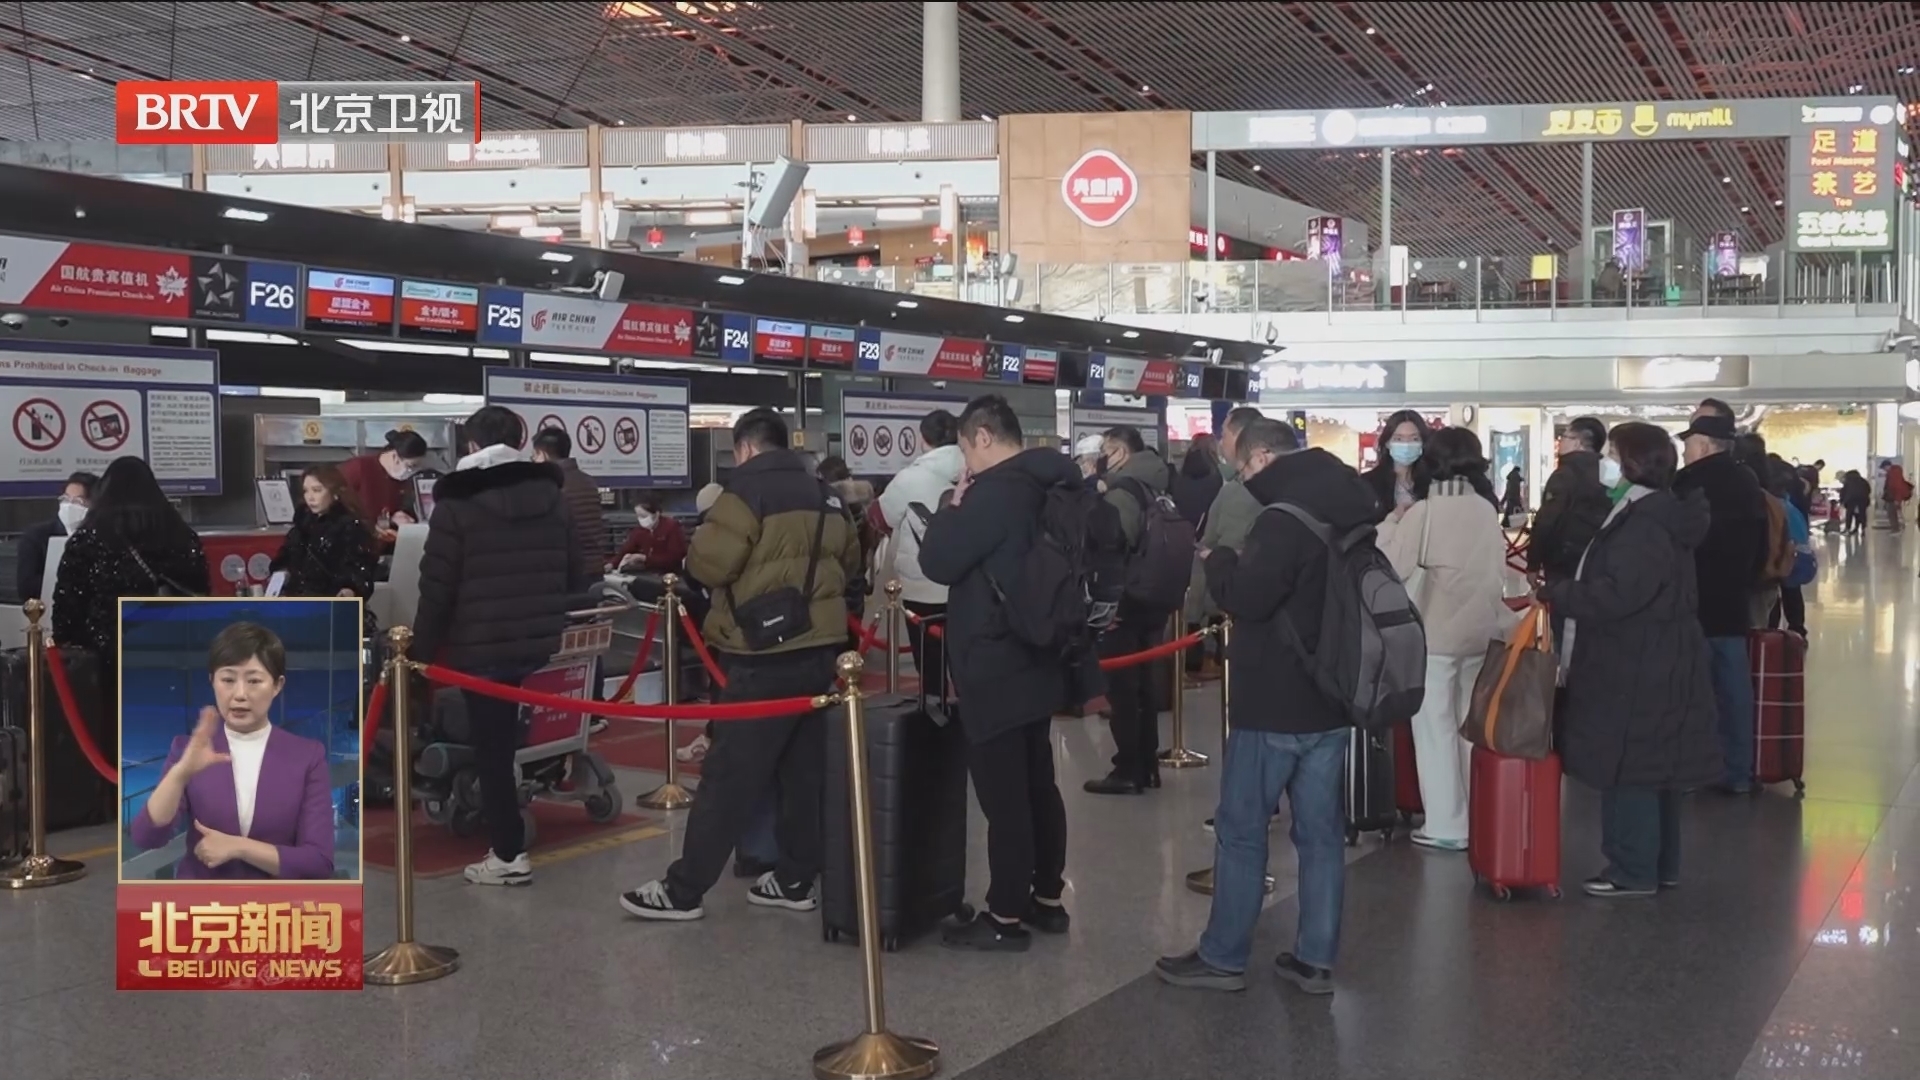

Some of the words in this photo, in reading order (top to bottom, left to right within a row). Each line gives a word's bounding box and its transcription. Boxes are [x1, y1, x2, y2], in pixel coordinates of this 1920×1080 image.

[1667, 108, 1733, 131] mymill
[61, 265, 149, 287] 国航贵宾值机
[50, 285, 62, 293] Air
[63, 285, 86, 295] China
[87, 287, 120, 298] Premium
[121, 290, 155, 300] Check-in
[251, 281, 294, 309] F26
[487, 304, 521, 329] F25
[552, 311, 567, 322] AIR
[569, 313, 596, 325] CHINA
[724, 329, 749, 349] F24
[858, 341, 880, 360] F23
[14, 361, 66, 372] Prohibited
[67, 362, 76, 372] in
[78, 362, 119, 374] Check-in
[123, 364, 162, 377] Baggage
[1003, 355, 1019, 373] F22
[1090, 363, 1104, 378] F21
[1187, 374, 1200, 387] F20
